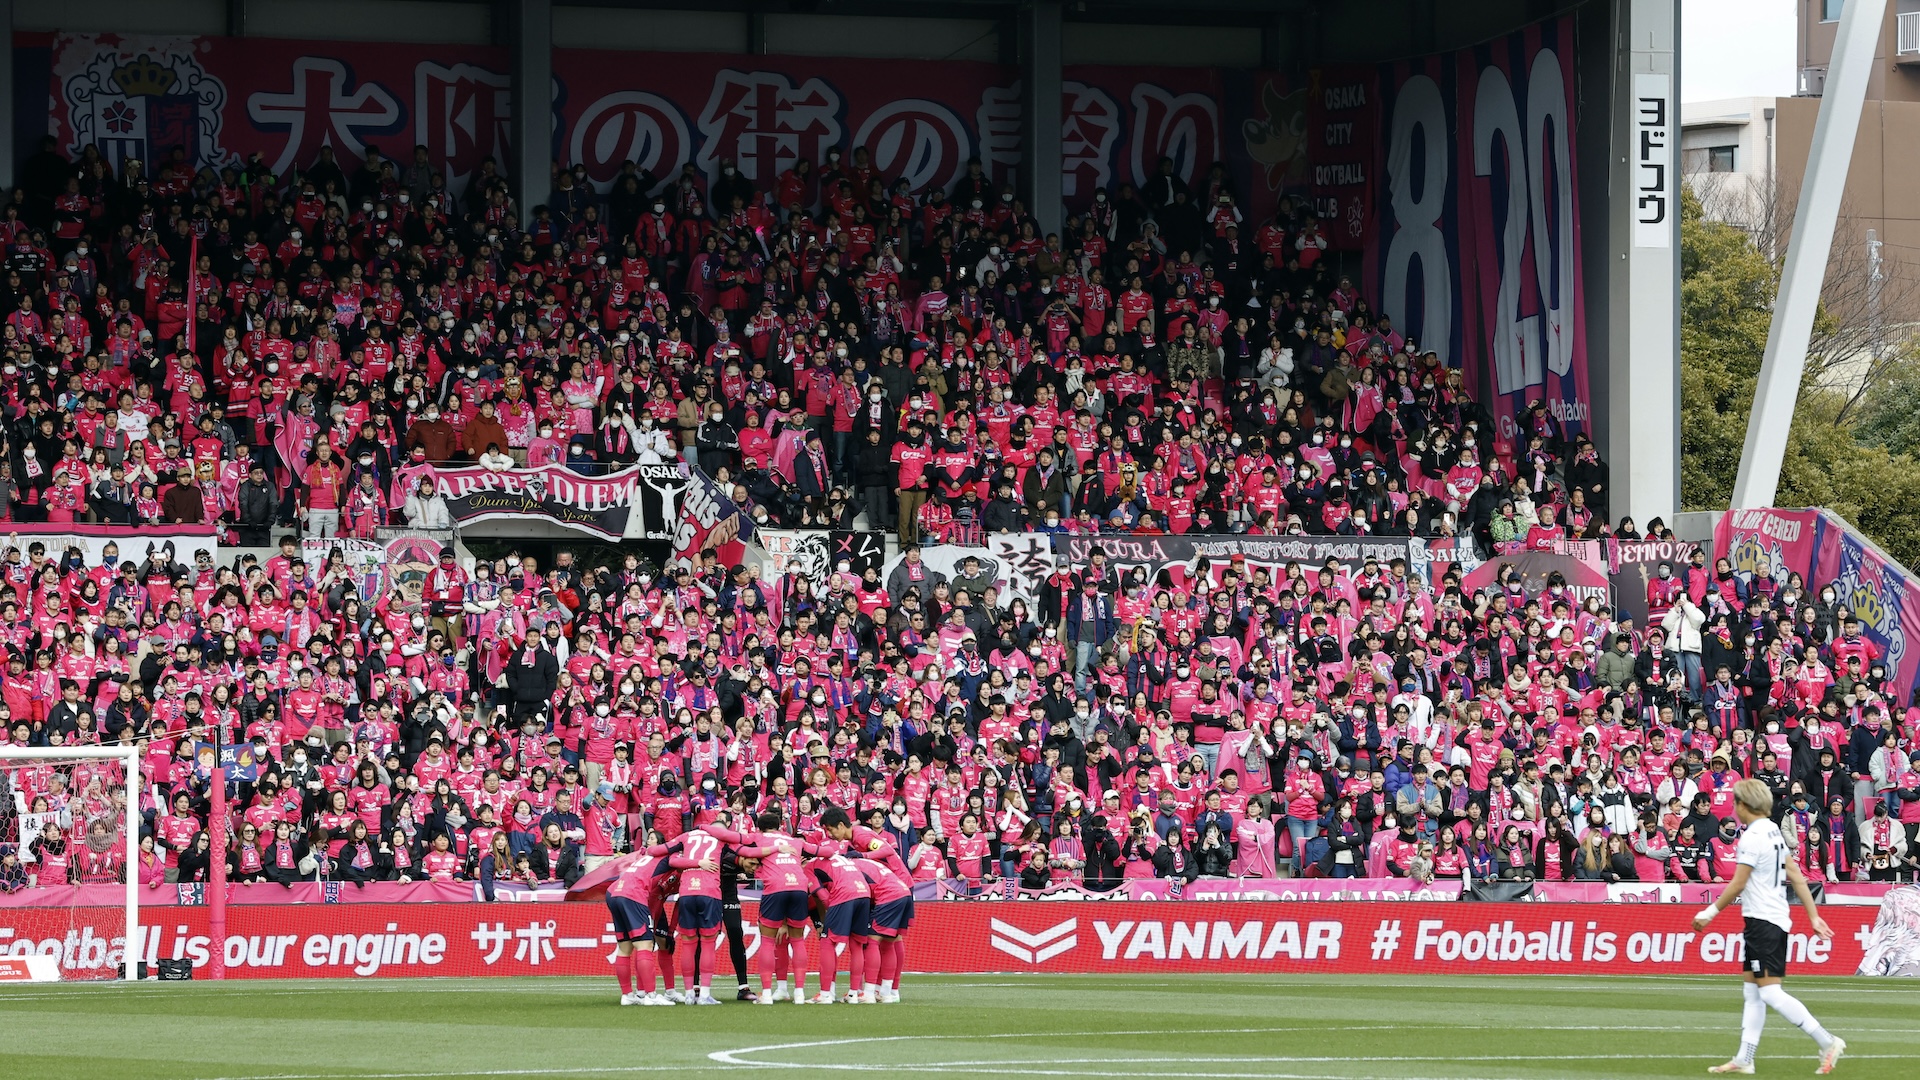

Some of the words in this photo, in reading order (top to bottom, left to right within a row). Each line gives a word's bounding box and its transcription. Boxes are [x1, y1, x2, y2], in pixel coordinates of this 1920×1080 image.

[1325, 84, 1366, 110] OSAKA
[1326, 122, 1352, 146] CITY
[1638, 97, 1666, 225] ヨドコウ
[1315, 163, 1365, 186] OOTBALL
[1383, 74, 1452, 358] 8
[1474, 47, 1575, 395] 20
[640, 466, 690, 479] OSAK
[436, 473, 524, 500] ARPE
[552, 474, 637, 512] DIEM
[1742, 510, 1764, 530] ARE
[1762, 513, 1802, 543] CEREZO
[762, 535, 792, 553] THE
[1069, 537, 1169, 562] SAKURA
[1191, 540, 1238, 556] MAKE
[1241, 540, 1311, 560] HISTORY
[1315, 542, 1358, 561] FROM
[1362, 543, 1407, 562] HERE
[911, 568, 921, 576] 21
[1568, 584, 1607, 606] OLVES
[1177, 619, 1187, 629] 38
[174, 925, 211, 968] is
[224, 936, 298, 968] our
[303, 923, 447, 976] engine
[1093, 920, 1343, 961] YANMAR
[1371, 919, 1402, 961] #
[1414, 920, 1574, 962] Football
[1583, 921, 1617, 962] is
[1626, 932, 1696, 964] our
[1700, 931, 1833, 964] enne
